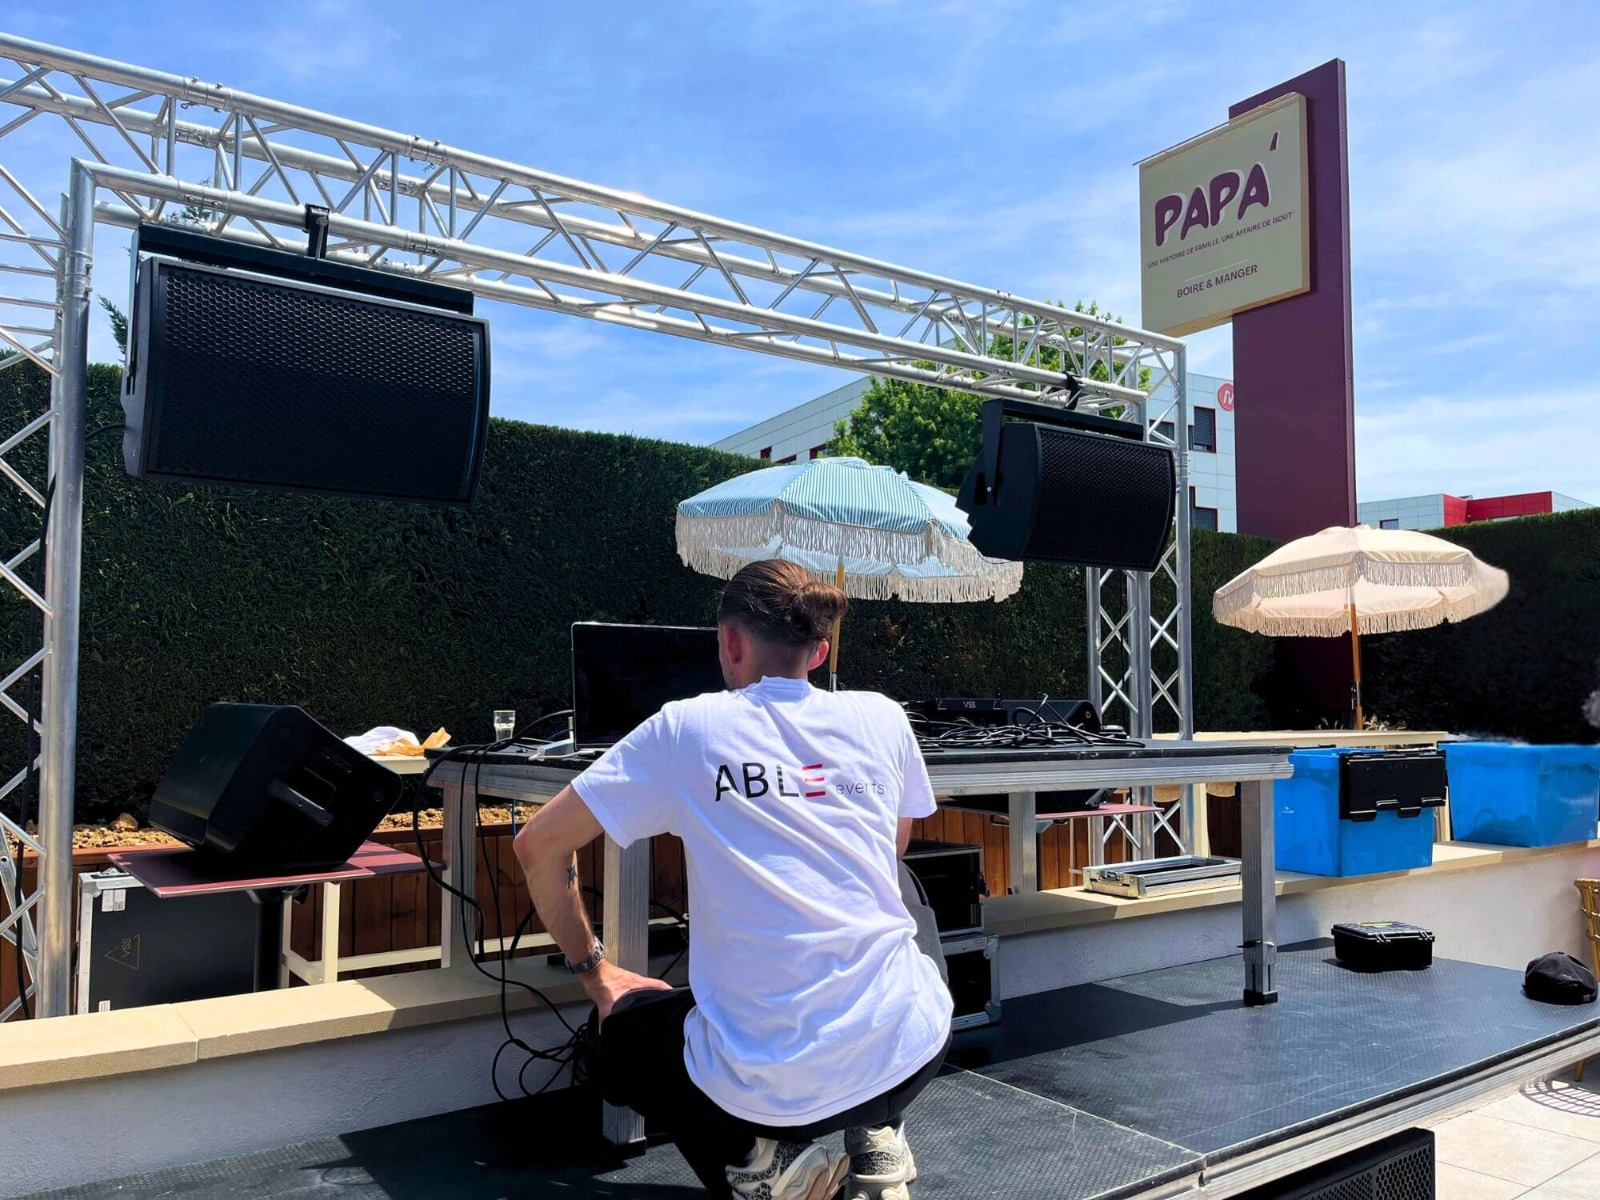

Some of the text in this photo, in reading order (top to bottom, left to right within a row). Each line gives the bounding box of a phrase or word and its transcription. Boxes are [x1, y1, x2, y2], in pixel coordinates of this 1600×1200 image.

[1147, 261, 1159, 269] UNE
[1159, 249, 1186, 265] HISTOIRE
[1221, 232, 1234, 242] UNE
[1235, 223, 1262, 237] AFFAIRE
[1261, 219, 1271, 228] DE
[1177, 264, 1258, 299] BOIRE & MANGER
[962, 700, 977, 709] VSS
[715, 762, 826, 802] ABLE
